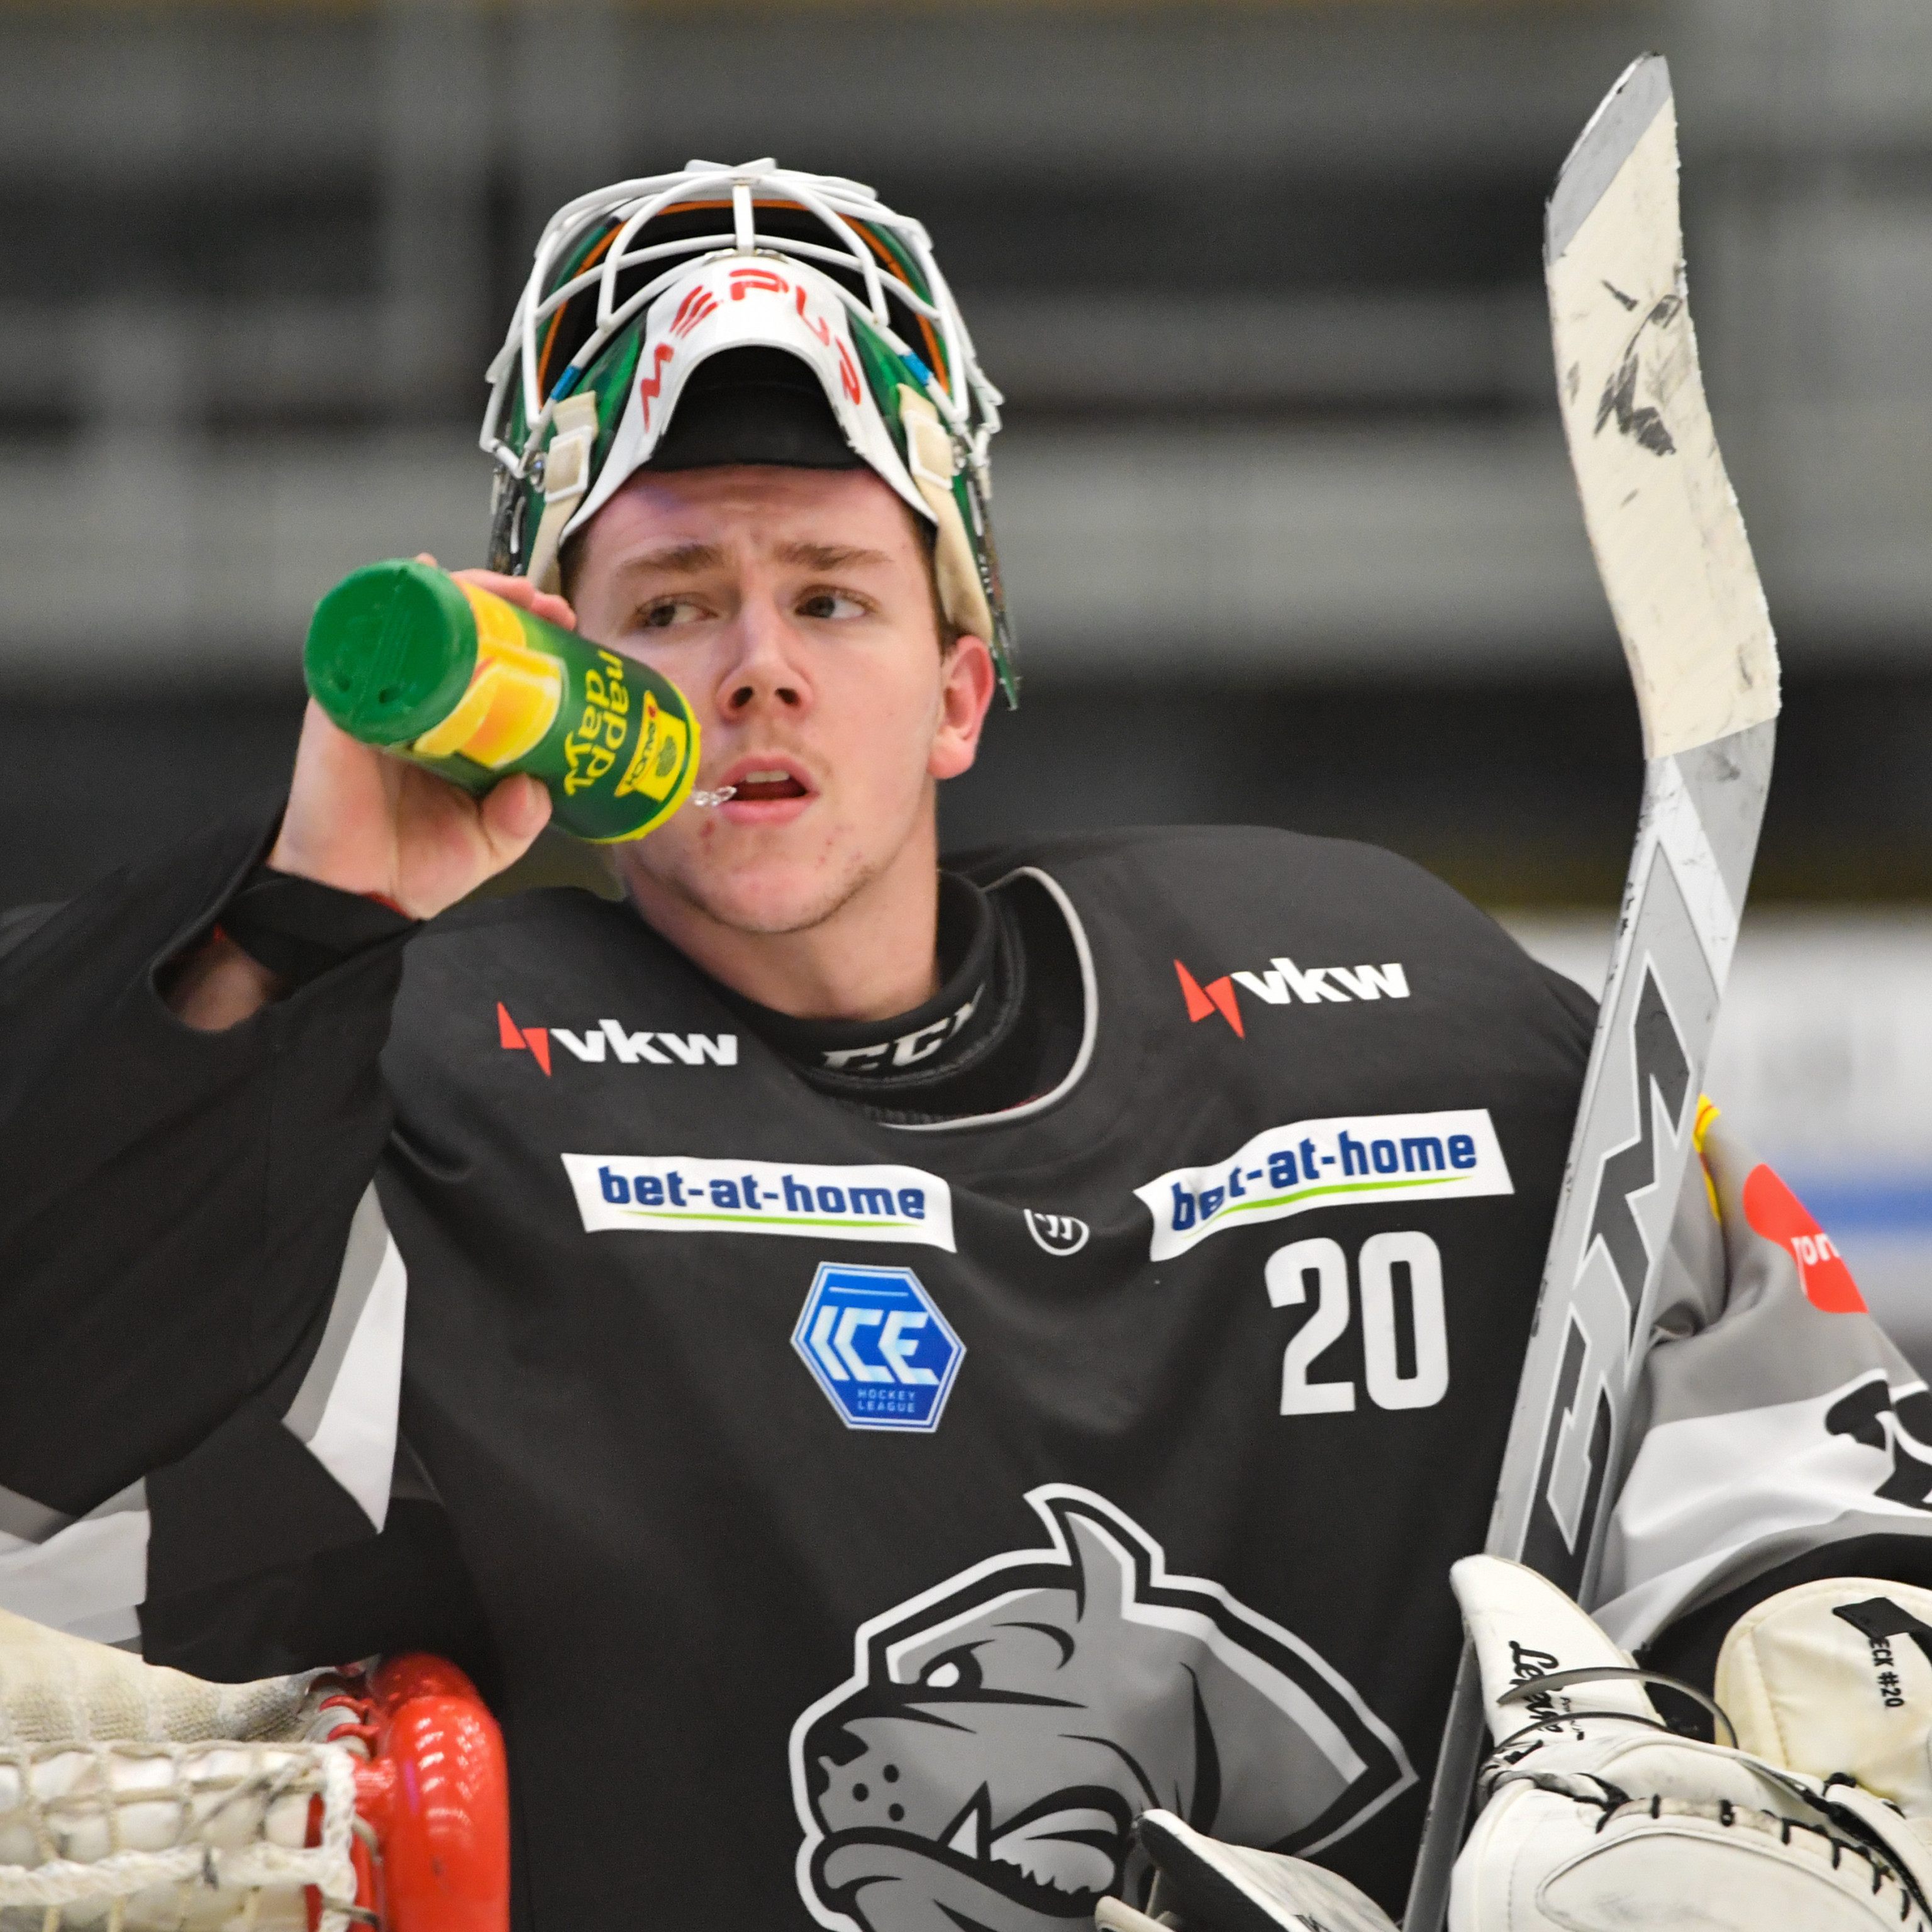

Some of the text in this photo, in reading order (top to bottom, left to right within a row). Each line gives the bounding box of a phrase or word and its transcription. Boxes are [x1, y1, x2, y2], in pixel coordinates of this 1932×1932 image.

[1229, 957, 1411, 1004] vkw
[548, 1018, 738, 1067] vkw
[597, 1165, 926, 1220] bet-at-home
[1171, 1130, 1478, 1231] bet-at-home
[809, 1304, 940, 1385] ICE
[1265, 1231, 1450, 1416] 20
[857, 1387, 916, 1400] HOCKEY
[857, 1401, 916, 1413] LEAGUE
[1877, 1670, 1905, 1708] #20
